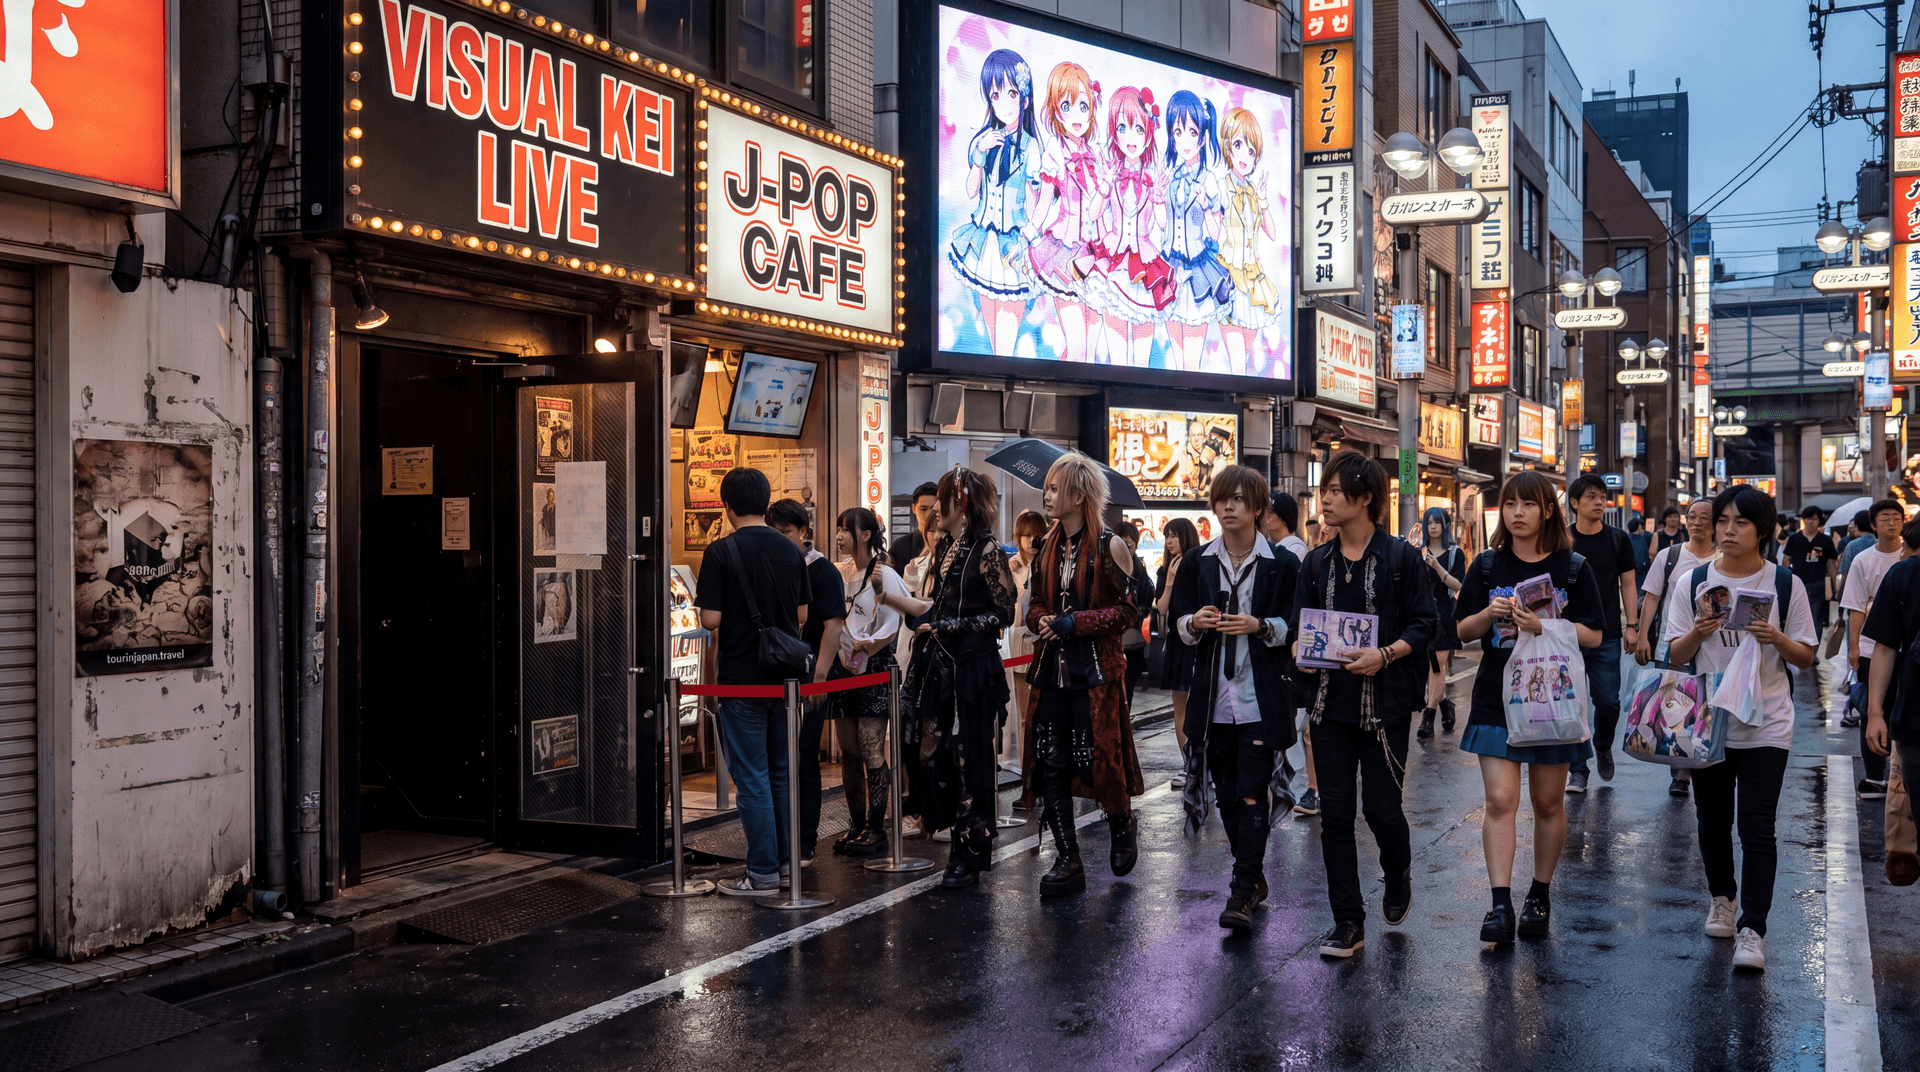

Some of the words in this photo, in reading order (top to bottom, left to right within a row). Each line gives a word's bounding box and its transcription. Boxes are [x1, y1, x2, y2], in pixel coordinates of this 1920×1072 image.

[379, 0, 590, 152] VISUAL
[601, 73, 674, 176] KEI
[478, 130, 599, 248] LIVE
[724, 140, 878, 244] J-POP
[740, 220, 866, 310] CAFE
[107, 649, 184, 664] tourinjapan.travel
